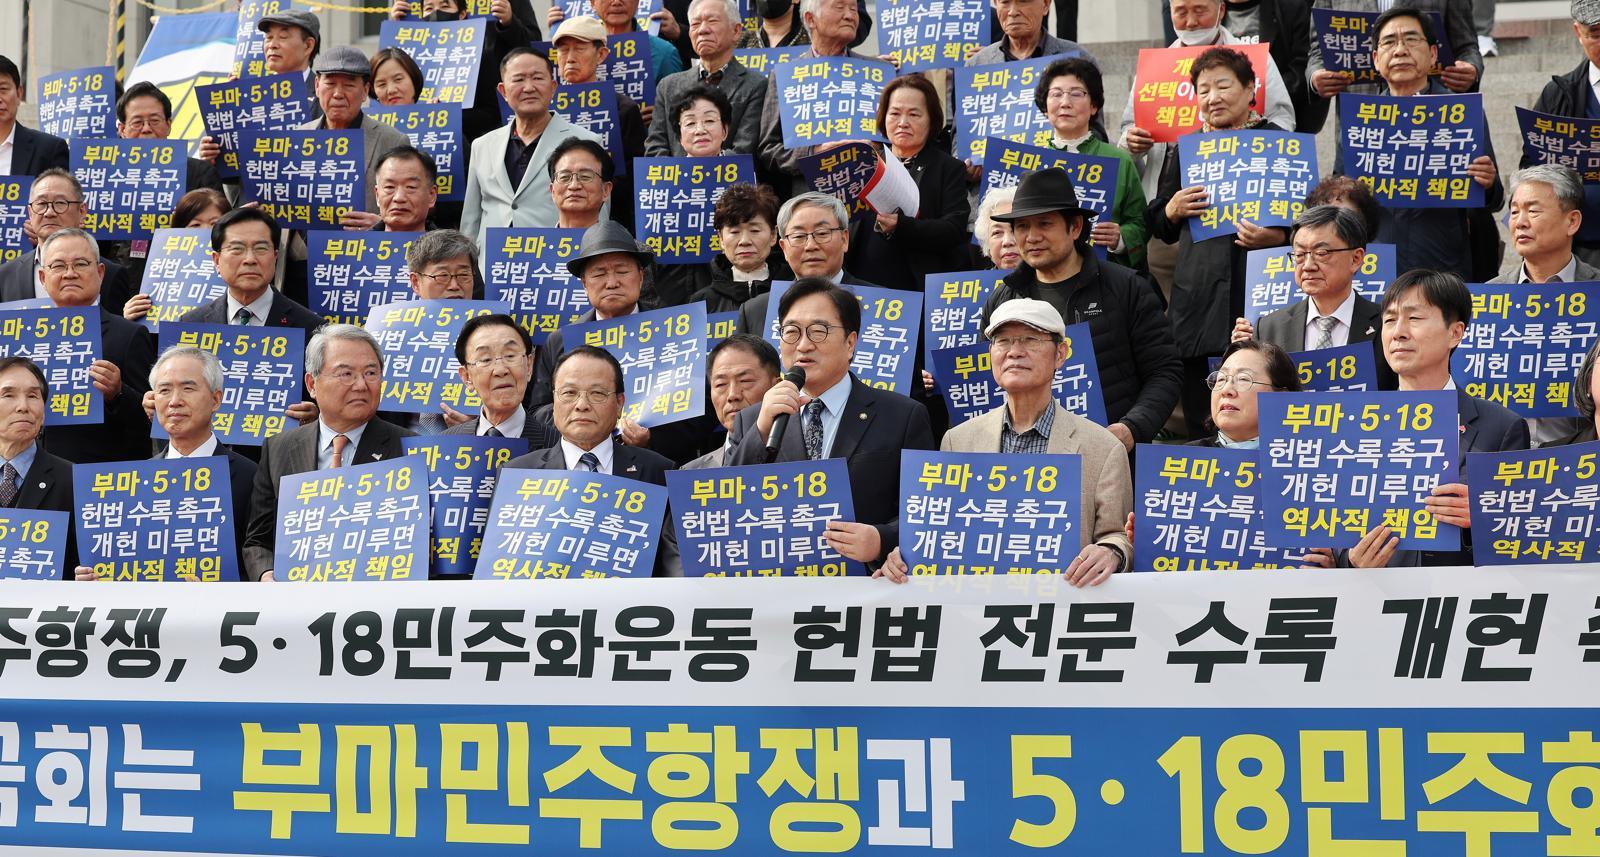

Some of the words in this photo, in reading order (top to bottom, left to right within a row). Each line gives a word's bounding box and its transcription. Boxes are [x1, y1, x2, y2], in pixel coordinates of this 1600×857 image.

[881, 8, 909, 28] 헌법
[911, 2, 945, 22] 수록
[947, 3, 985, 20] 촉구,
[888, 29, 918, 47] 개헌
[925, 22, 979, 41] 미루면
[1323, 34, 1357, 51] 헌법
[416, 48, 448, 65] 수록
[448, 46, 477, 64] 촉구,
[426, 65, 471, 85] 미루면
[611, 60, 648, 80] 촉구,
[439, 85, 467, 103] 책임
[784, 82, 818, 103] 헌법
[821, 81, 857, 98] 수록
[962, 93, 997, 115] 헌법
[40, 101, 55, 122] 헌법
[55, 97, 77, 114] 수록
[78, 95, 110, 113] 촉구,
[206, 110, 234, 131] 헌법
[236, 106, 267, 127] 수록
[269, 105, 305, 122] 촉구,
[577, 110, 613, 131] 촉구,
[793, 100, 830, 120] 개헌
[795, 118, 851, 139] 역사적
[970, 113, 1007, 136] 개헌
[421, 132, 457, 151] 촉구,
[1348, 126, 1384, 149] 헌법
[1387, 130, 1429, 151] 수록
[1432, 129, 1477, 151] 촉구,
[1527, 131, 1564, 152] 헌법
[246, 160, 278, 179] 헌법
[281, 161, 317, 180] 수록
[319, 160, 359, 181] 촉구,
[1188, 160, 1225, 184] 헌법
[1228, 158, 1268, 177] 수록
[1271, 158, 1313, 180] 촉구,
[1356, 152, 1395, 174] 개헌
[108, 169, 141, 188] 수록
[144, 168, 180, 190] 촉구,
[814, 167, 850, 191] 헌법
[1246, 178, 1307, 199] 미루면
[1427, 178, 1470, 200] 책임
[121, 191, 174, 211] 미루면
[256, 183, 289, 201] 개헌
[298, 183, 353, 203] 미루면
[639, 189, 669, 209] 헌법
[672, 189, 707, 209] 수록
[645, 213, 679, 233] 개헌
[149, 258, 181, 278] 헌법
[180, 260, 215, 280] 수록
[314, 264, 350, 286] 헌법
[353, 266, 392, 287] 수록
[492, 262, 529, 284] 헌법
[149, 282, 184, 302] 개헌
[321, 290, 360, 311] 개헌
[1252, 281, 1291, 307] 헌법
[931, 307, 966, 331] 헌법
[407, 331, 450, 353] 수록
[862, 324, 908, 353] 촉구,
[1499, 324, 1545, 349] 수록
[620, 347, 656, 374] 수록
[659, 338, 701, 365] 촉구,
[1464, 353, 1509, 378] 개헌
[252, 362, 295, 388] 촉구,
[633, 363, 693, 397] 미루면
[50, 392, 91, 416] 책임
[223, 389, 289, 412] 미루면
[651, 390, 691, 416] 책임
[949, 381, 989, 407] 헌법
[1269, 439, 1322, 467] 헌법
[1327, 439, 1383, 468] 수록
[1388, 439, 1449, 470] 촉구,
[1281, 474, 1338, 502] 개헌
[82, 502, 123, 528] 헌법
[127, 500, 172, 526] 수록
[176, 497, 225, 523] 촉구,
[1145, 489, 1197, 519] 헌법
[1200, 494, 1255, 524] 수록
[1479, 489, 1535, 512] 헌법
[284, 506, 325, 535] 헌법
[327, 502, 372, 528] 수록
[376, 495, 422, 522] 촉구,
[682, 510, 729, 538] 헌법
[735, 507, 786, 535] 수록
[907, 495, 951, 525] 헌법
[955, 499, 1008, 528] 수록
[1012, 501, 1071, 531] 촉구,
[1283, 508, 1369, 537] 역사적
[497, 505, 545, 527] 헌법
[545, 507, 596, 534] 수록
[598, 514, 649, 549] 촉구,
[1153, 524, 1210, 553] 개헌
[1492, 516, 1552, 537] 개헌
[91, 531, 137, 557] 개헌
[148, 526, 218, 554] 미루면
[289, 533, 334, 561] 개헌
[343, 524, 415, 554] 미루면
[498, 531, 550, 555] 개헌
[557, 536, 639, 574] 미루면
[698, 540, 748, 567] 개헌
[912, 531, 965, 559] 개헌
[977, 533, 1062, 563] 미루면
[1493, 537, 1585, 560] 역사적
[364, 553, 414, 580] 책임
[219, 605, 758, 682] 5·18민주화운동
[793, 604, 941, 683] 헌법
[980, 602, 1155, 683] 전문
[1166, 597, 1337, 683] 수록
[1380, 592, 1549, 683] 개헌
[233, 721, 965, 854] 부마민주항쟁과
